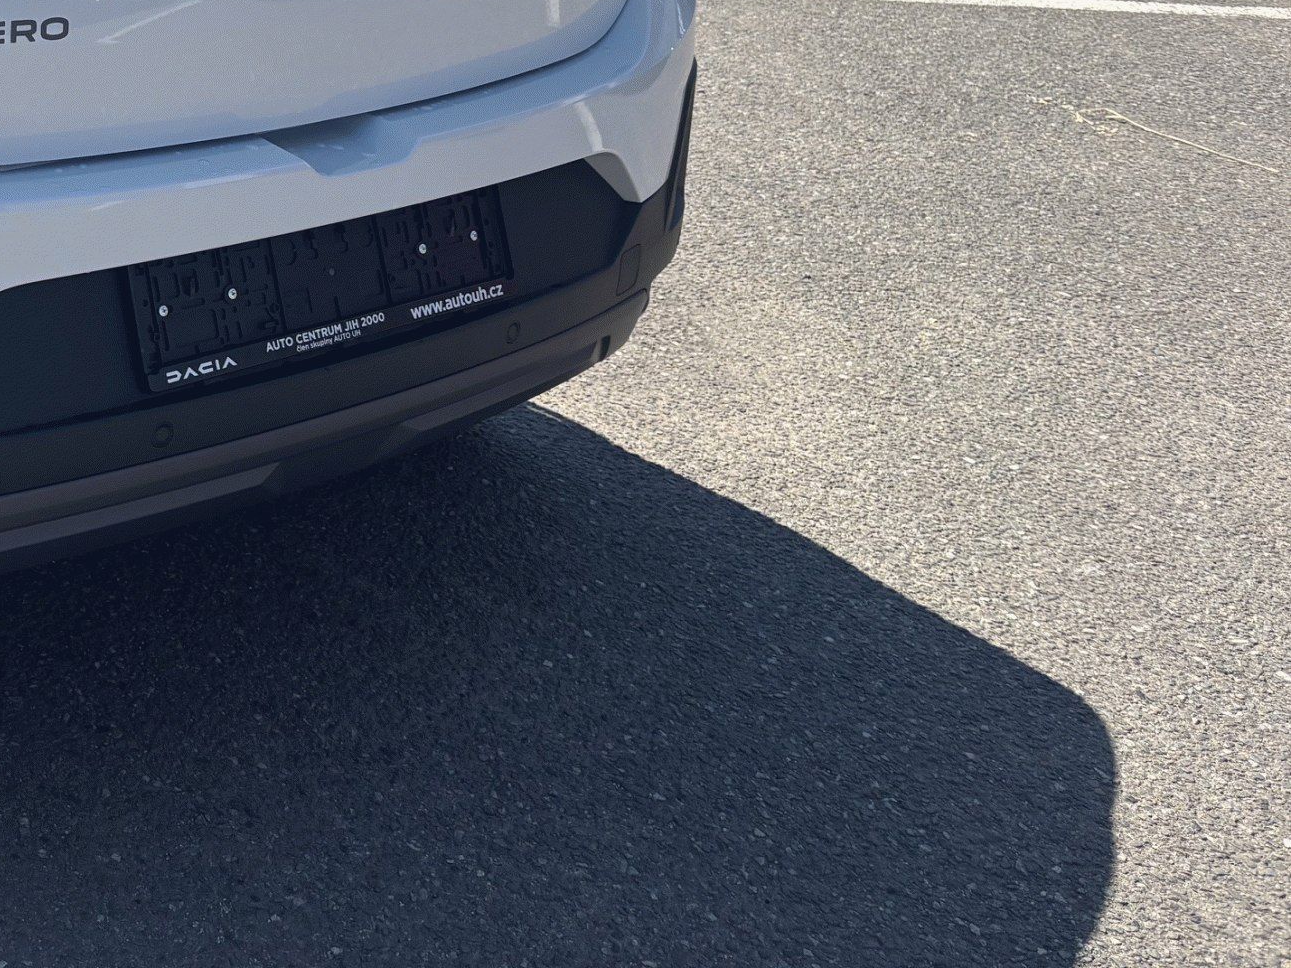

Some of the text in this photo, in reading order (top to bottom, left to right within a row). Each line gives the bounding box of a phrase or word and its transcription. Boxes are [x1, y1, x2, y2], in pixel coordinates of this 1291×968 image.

[410, 284, 504, 319] www.autouh.cz
[266, 312, 385, 353] AUTO CENTRUM JIH 2000
[333, 333, 352, 343] AUTO
[351, 329, 362, 338] UH
[165, 356, 238, 384] DACIA
